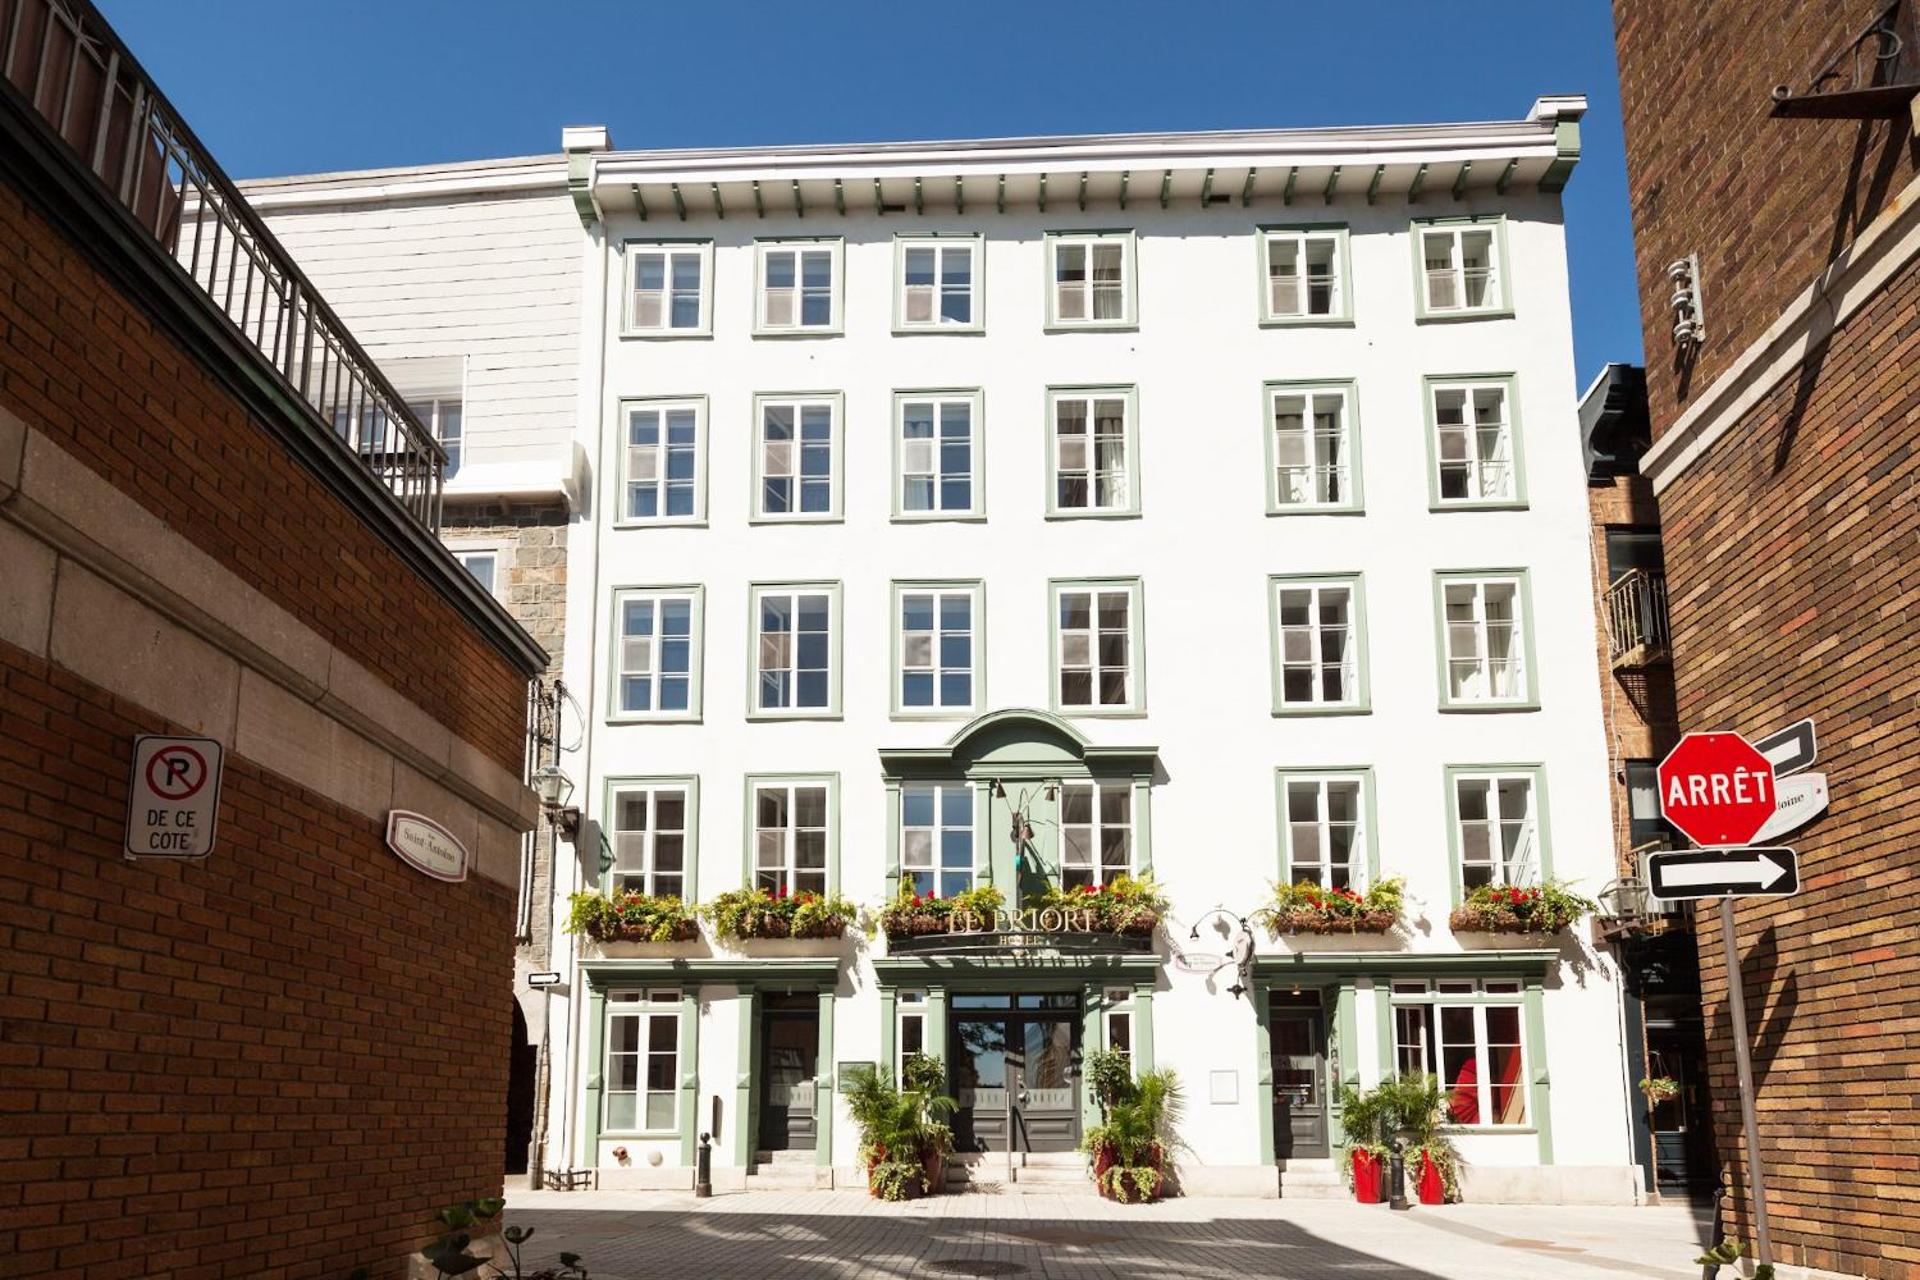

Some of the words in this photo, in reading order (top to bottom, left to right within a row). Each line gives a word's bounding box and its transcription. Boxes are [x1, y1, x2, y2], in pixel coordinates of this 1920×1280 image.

[1668, 766, 1768, 807] ARRÊT
[147, 809, 168, 827] DE
[175, 811, 196, 827] CE
[149, 832, 190, 850] COTE
[948, 910, 983, 933] LE
[993, 907, 1094, 933] PRIORI
